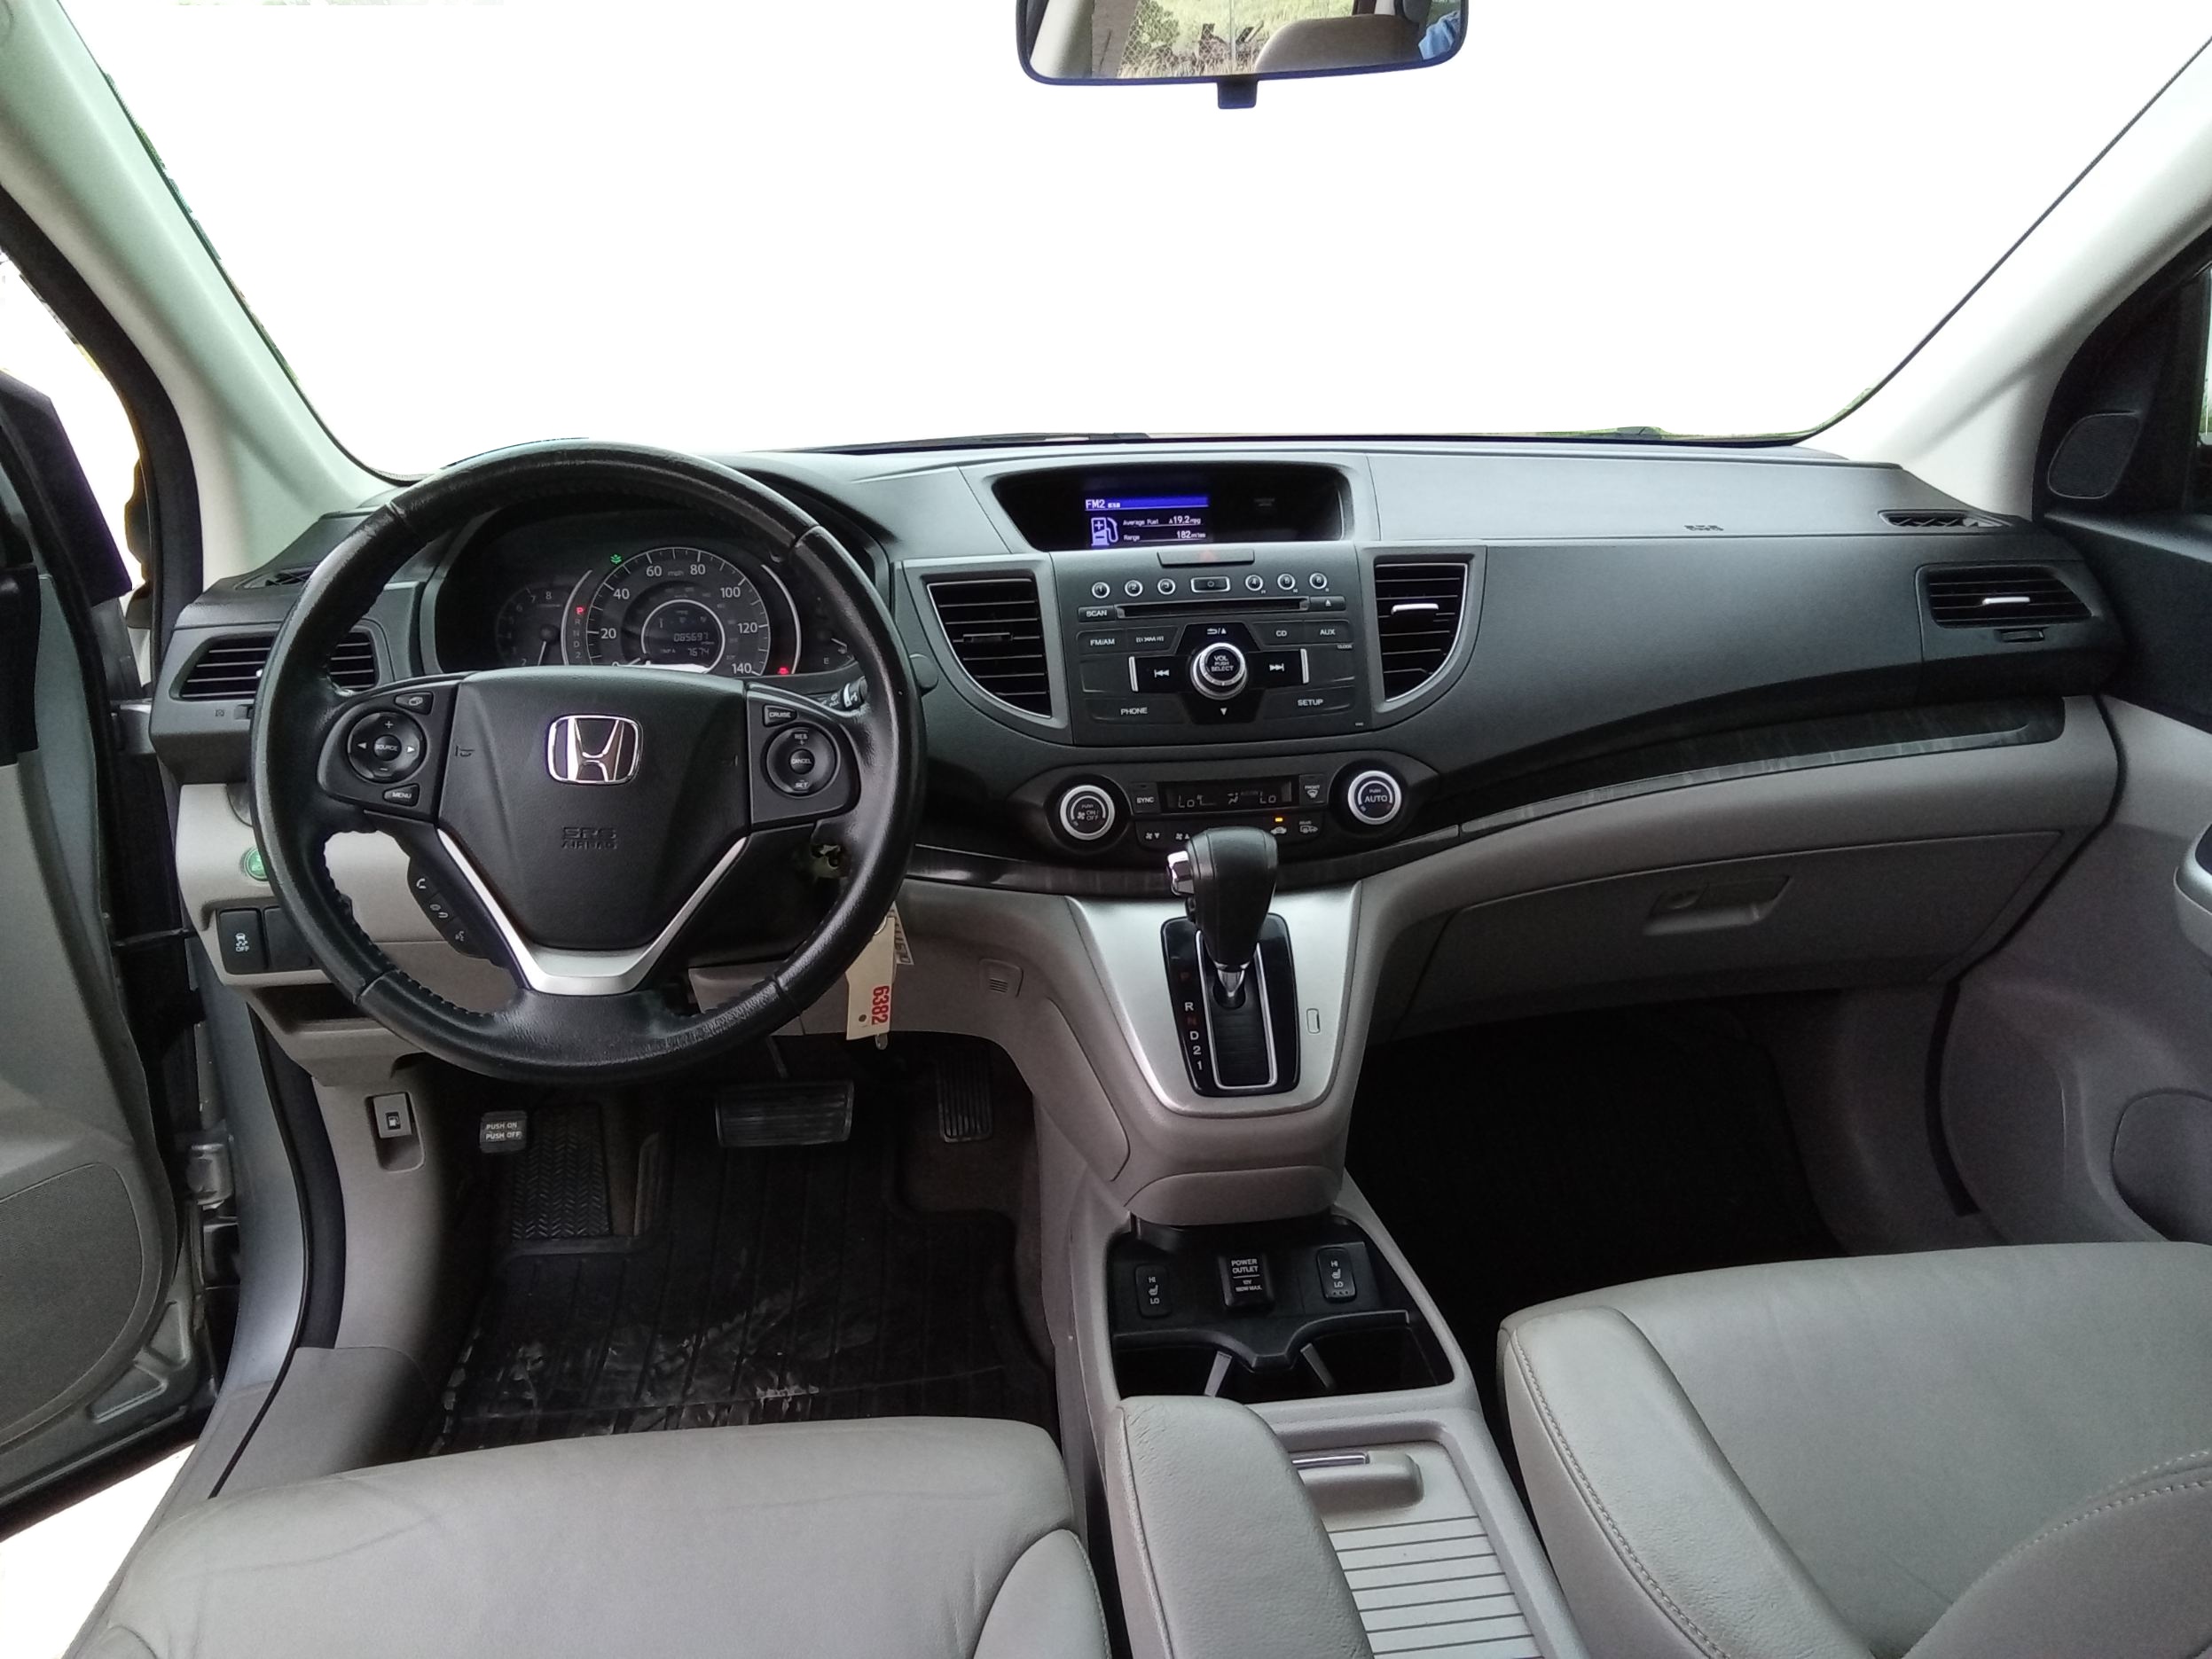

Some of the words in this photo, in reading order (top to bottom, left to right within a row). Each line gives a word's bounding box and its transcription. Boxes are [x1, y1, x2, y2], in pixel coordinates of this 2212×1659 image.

[1085, 499, 1106, 509] FM2
[646, 566, 663, 576] 60
[690, 564, 706, 575] 80
[545, 591, 552, 600] 8
[613, 588, 631, 600] 40
[720, 586, 741, 599] 100
[738, 622, 758, 634] 120
[600, 628, 617, 639] 20
[1089, 638, 1116, 646] FM/AM
[732, 662, 753, 674] 140
[1297, 698, 1324, 707] SETUP
[1120, 707, 1149, 716] PHONE
[1364, 794, 1388, 803] AUTO
[872, 985, 890, 1026] 6382
[1185, 1002, 1194, 1012] R
[1189, 1030, 1199, 1040] D
[1193, 1045, 1202, 1055] 2
[1196, 1060, 1203, 1070] 1
[485, 1131, 505, 1140] PUSH
[1231, 1258, 1258, 1267] POWER
[1232, 1265, 1259, 1274] OUTLET
